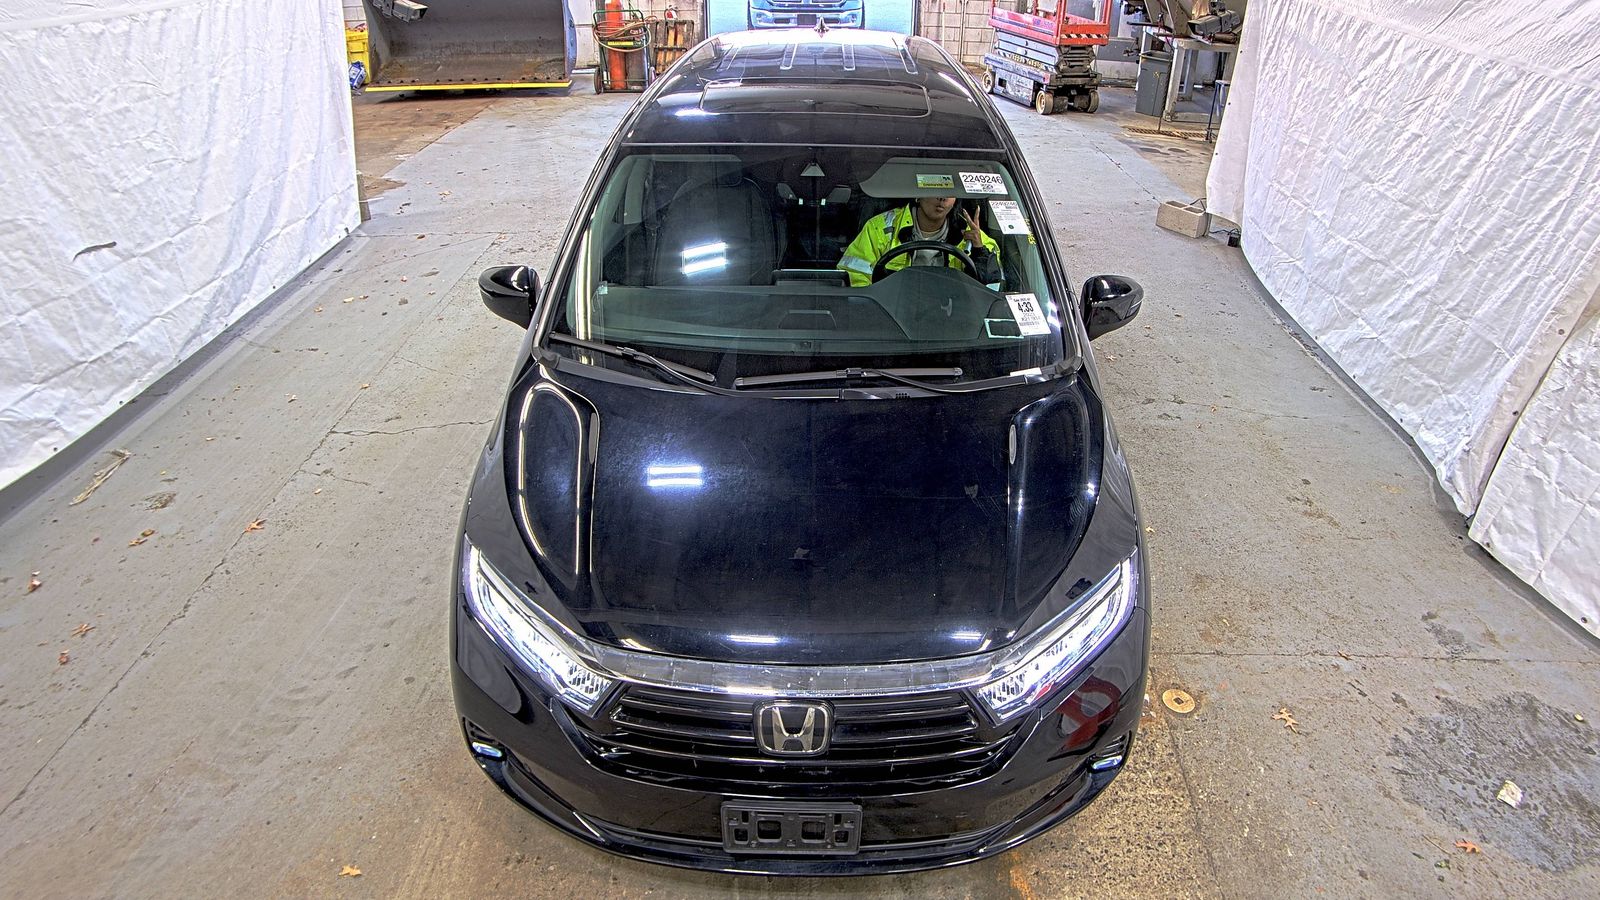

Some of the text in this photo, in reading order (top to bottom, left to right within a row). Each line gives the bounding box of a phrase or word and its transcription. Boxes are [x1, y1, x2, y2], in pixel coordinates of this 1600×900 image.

[962, 174, 1003, 184] 2249246
[1018, 301, 1034, 313] 4:33
[771, 706, 816, 753] H
